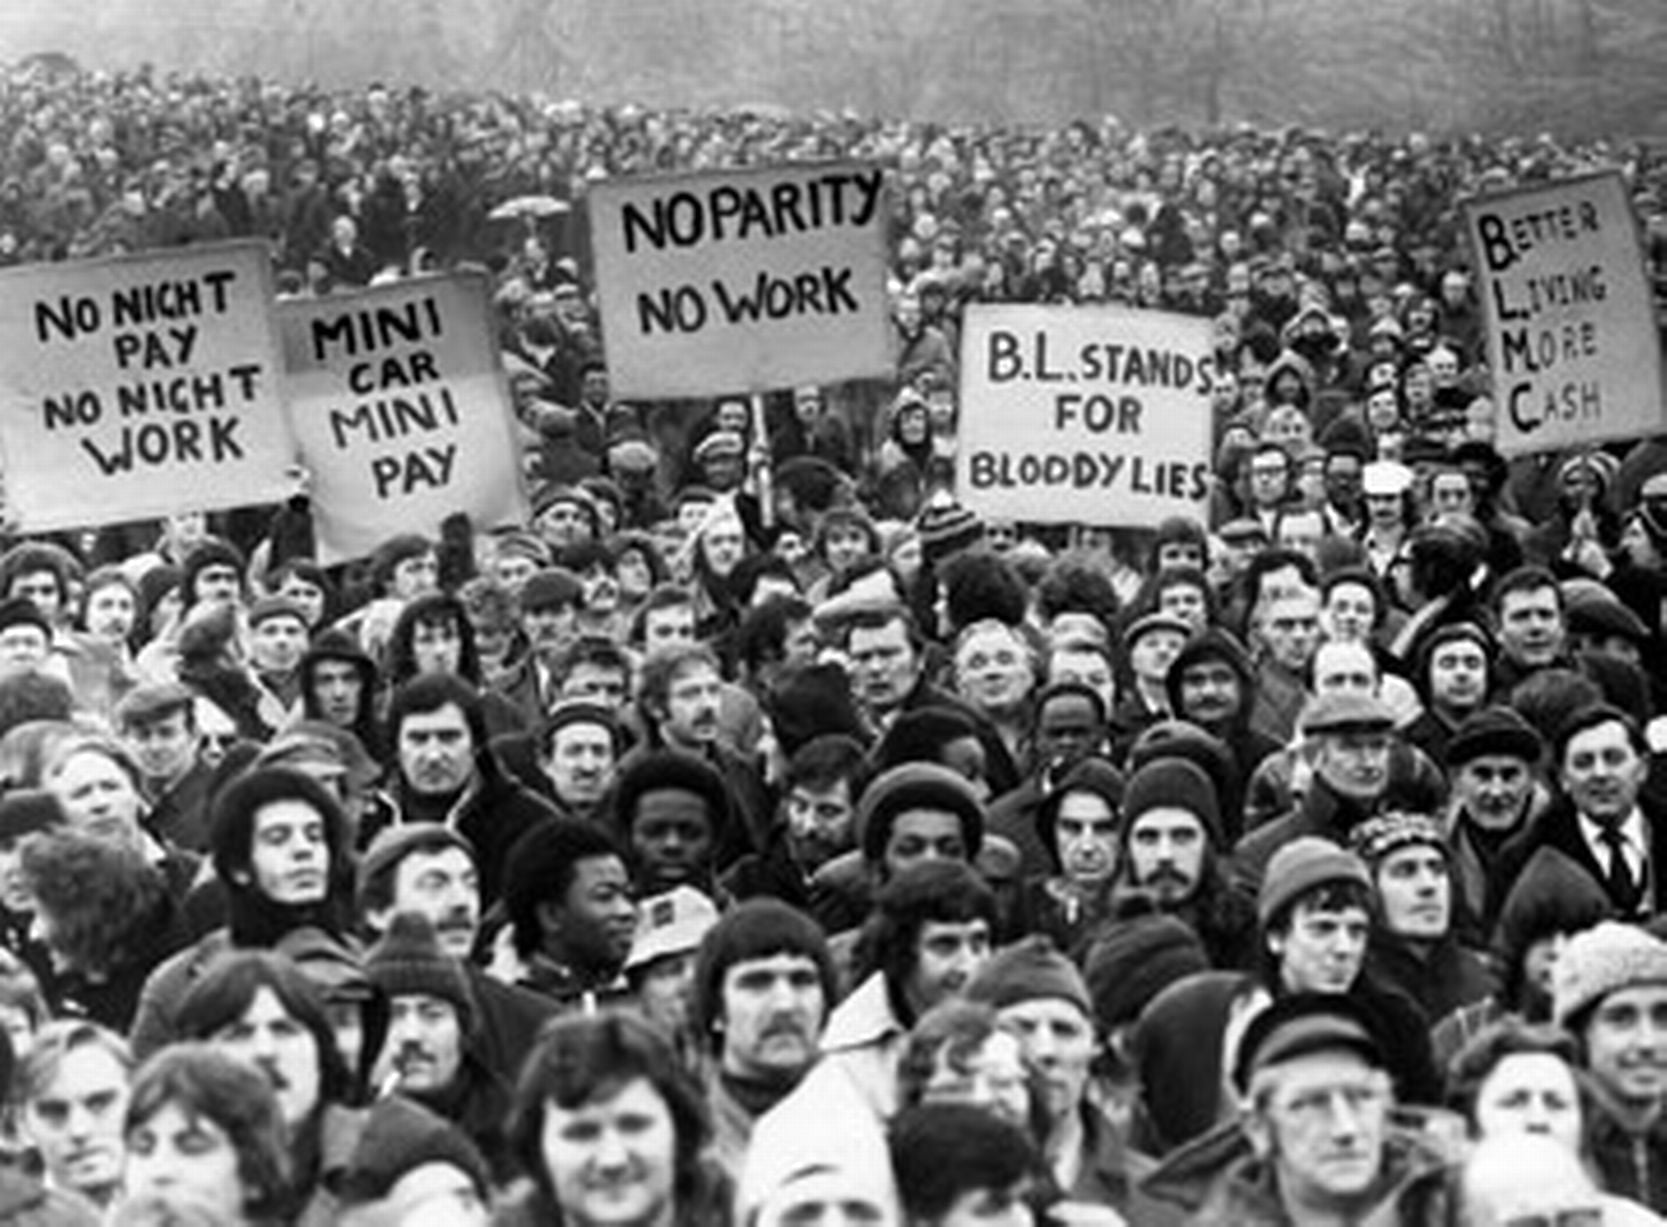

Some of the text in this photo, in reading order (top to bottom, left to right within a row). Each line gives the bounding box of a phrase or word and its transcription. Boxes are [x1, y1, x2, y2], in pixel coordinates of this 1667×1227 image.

[35, 296, 100, 342] NO
[637, 266, 859, 334] NO WORK
[114, 325, 197, 369] PAY
[311, 298, 442, 360] MINI
[1502, 321, 1597, 373] MORE
[349, 351, 441, 394] CAR
[43, 391, 101, 430] NO
[330, 387, 458, 449] MINI
[1056, 394, 1142, 433] FOR
[1509, 381, 1602, 434] CASH
[81, 416, 244, 475] WORK
[371, 444, 457, 498] PAY
[1130, 456, 1208, 501] LIES
